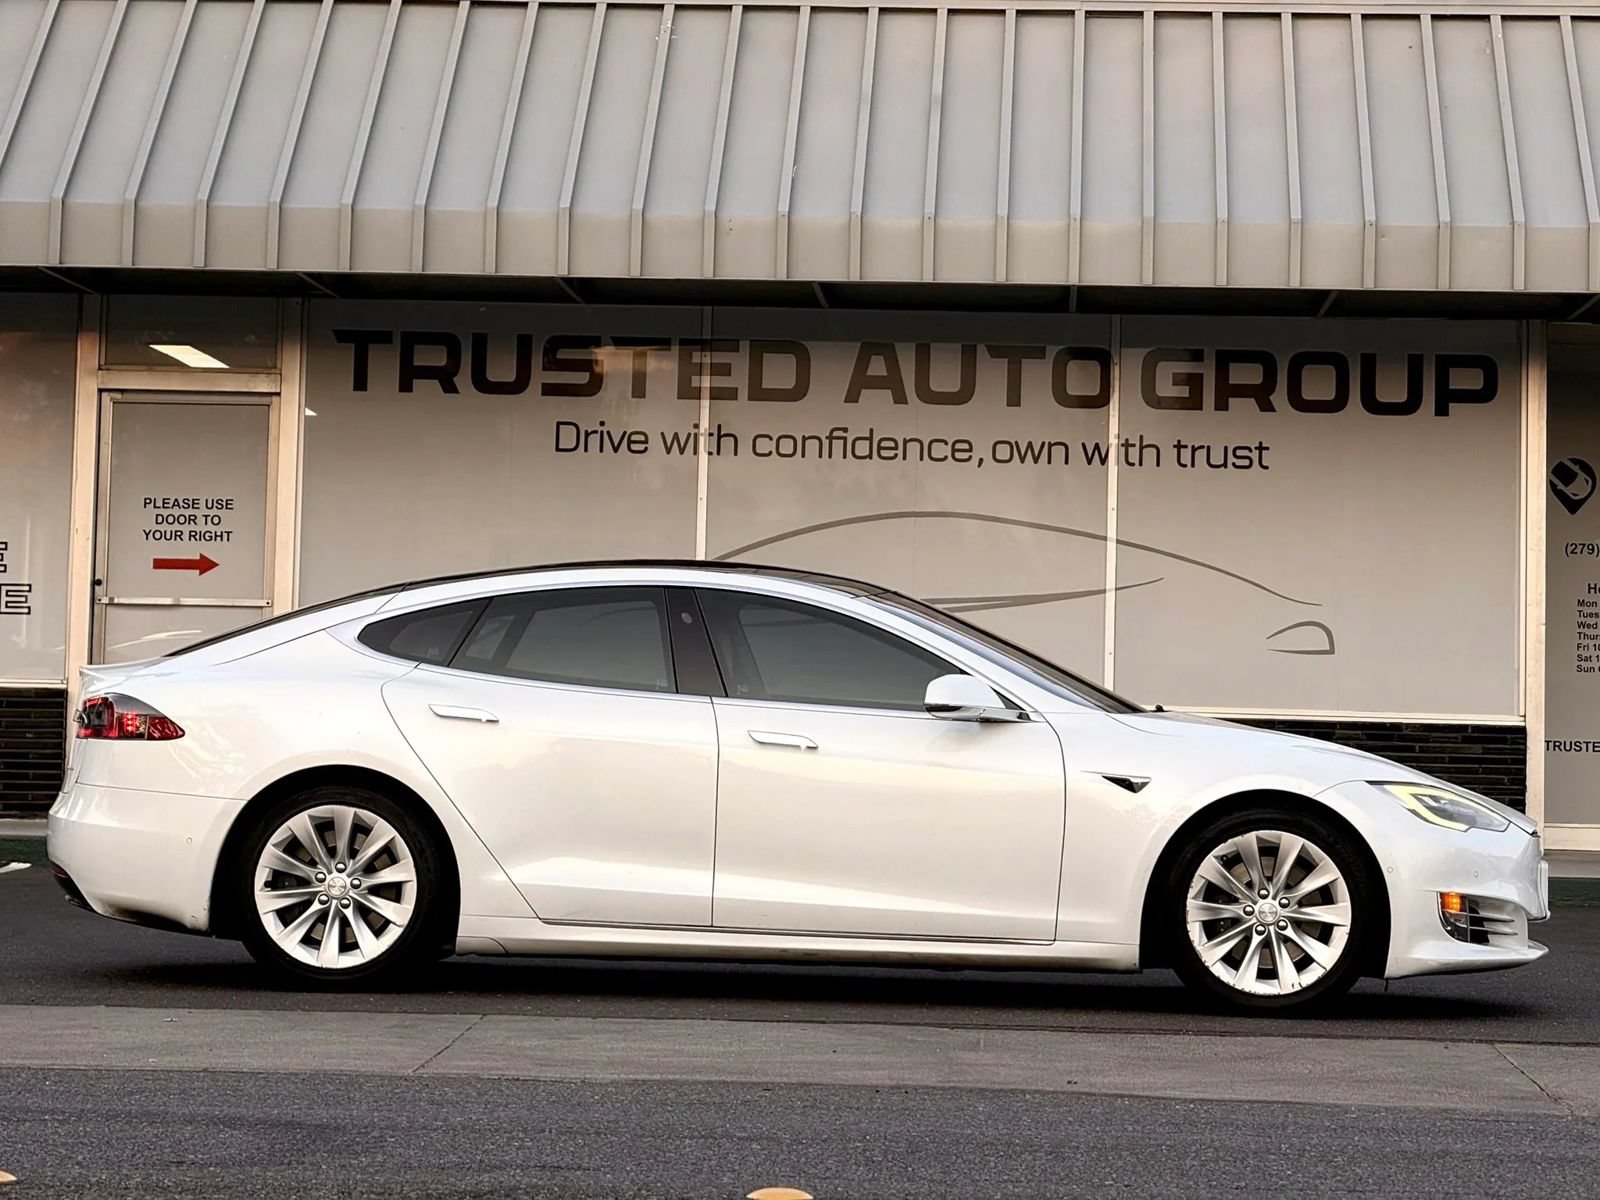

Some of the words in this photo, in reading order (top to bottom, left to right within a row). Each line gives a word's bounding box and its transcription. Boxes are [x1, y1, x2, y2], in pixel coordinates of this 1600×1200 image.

[333, 329, 811, 403] TRUSTED
[843, 341, 1115, 409] AUTO
[1140, 347, 1499, 417] GROUP
[554, 421, 649, 454] Drive
[751, 426, 984, 468] confidence,
[991, 439, 1070, 465] own
[1172, 439, 1270, 470] trust
[143, 497, 200, 509] PLEASE
[205, 498, 234, 510] USE
[155, 513, 198, 526] DOOR
[202, 514, 222, 526] TO
[143, 529, 184, 542] YOUR
[188, 530, 233, 542] RIGHT
[1565, 542, 1600, 558] (279)
[1587, 583, 1600, 594] H
[1577, 599, 1598, 608] Mon
[1577, 609, 1600, 618] Tues
[1577, 621, 1598, 630] Wed
[1577, 632, 1600, 641] Thur
[1577, 643, 1590, 652] Fri
[1577, 654, 1593, 663] Sat
[1576, 664, 1596, 673] Sun
[1544, 740, 1600, 753] TRUSTE
